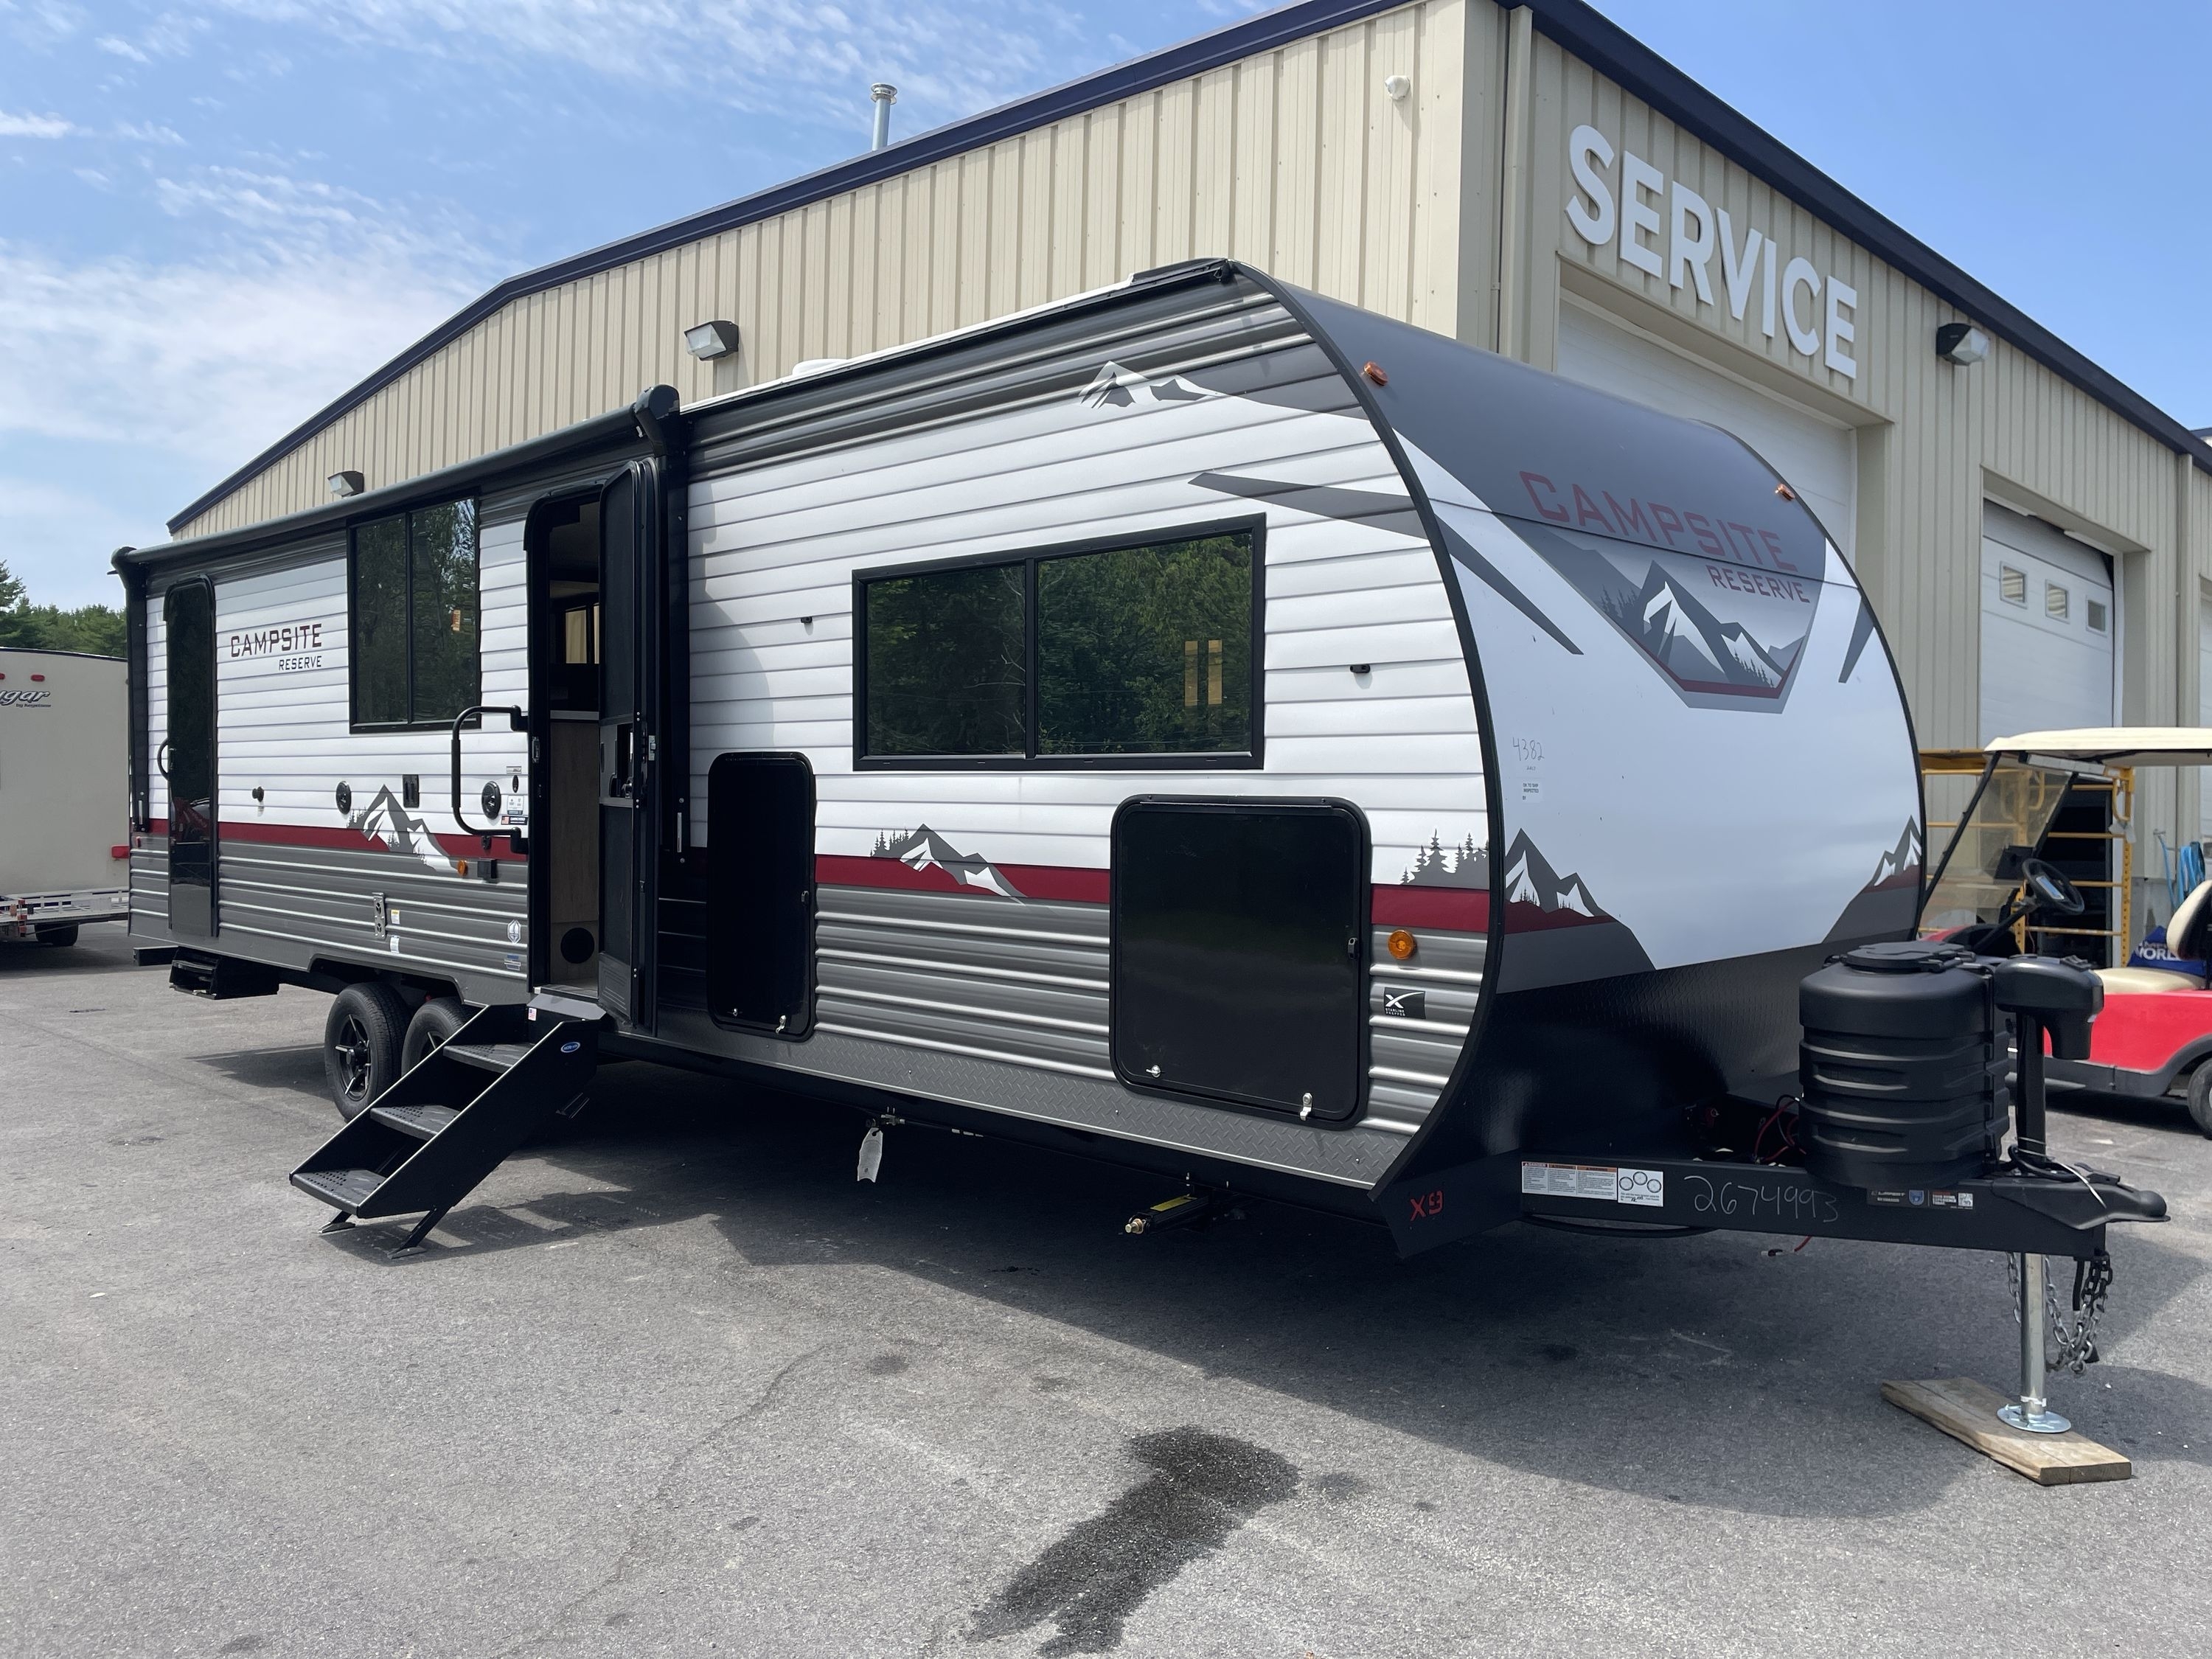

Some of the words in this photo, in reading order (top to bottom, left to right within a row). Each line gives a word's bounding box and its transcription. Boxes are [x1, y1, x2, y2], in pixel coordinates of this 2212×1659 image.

[1564, 125, 1857, 379] SERVICE
[1519, 470, 1798, 572] CAMPSITE
[1705, 565, 1810, 604] RESERVE
[231, 623, 322, 658] CAMPSITE
[279, 655, 322, 671] RESERVE
[1512, 737, 1545, 762] 4382
[2135, 947, 2181, 961] ORL
[1684, 1175, 1839, 1223] 2674993
